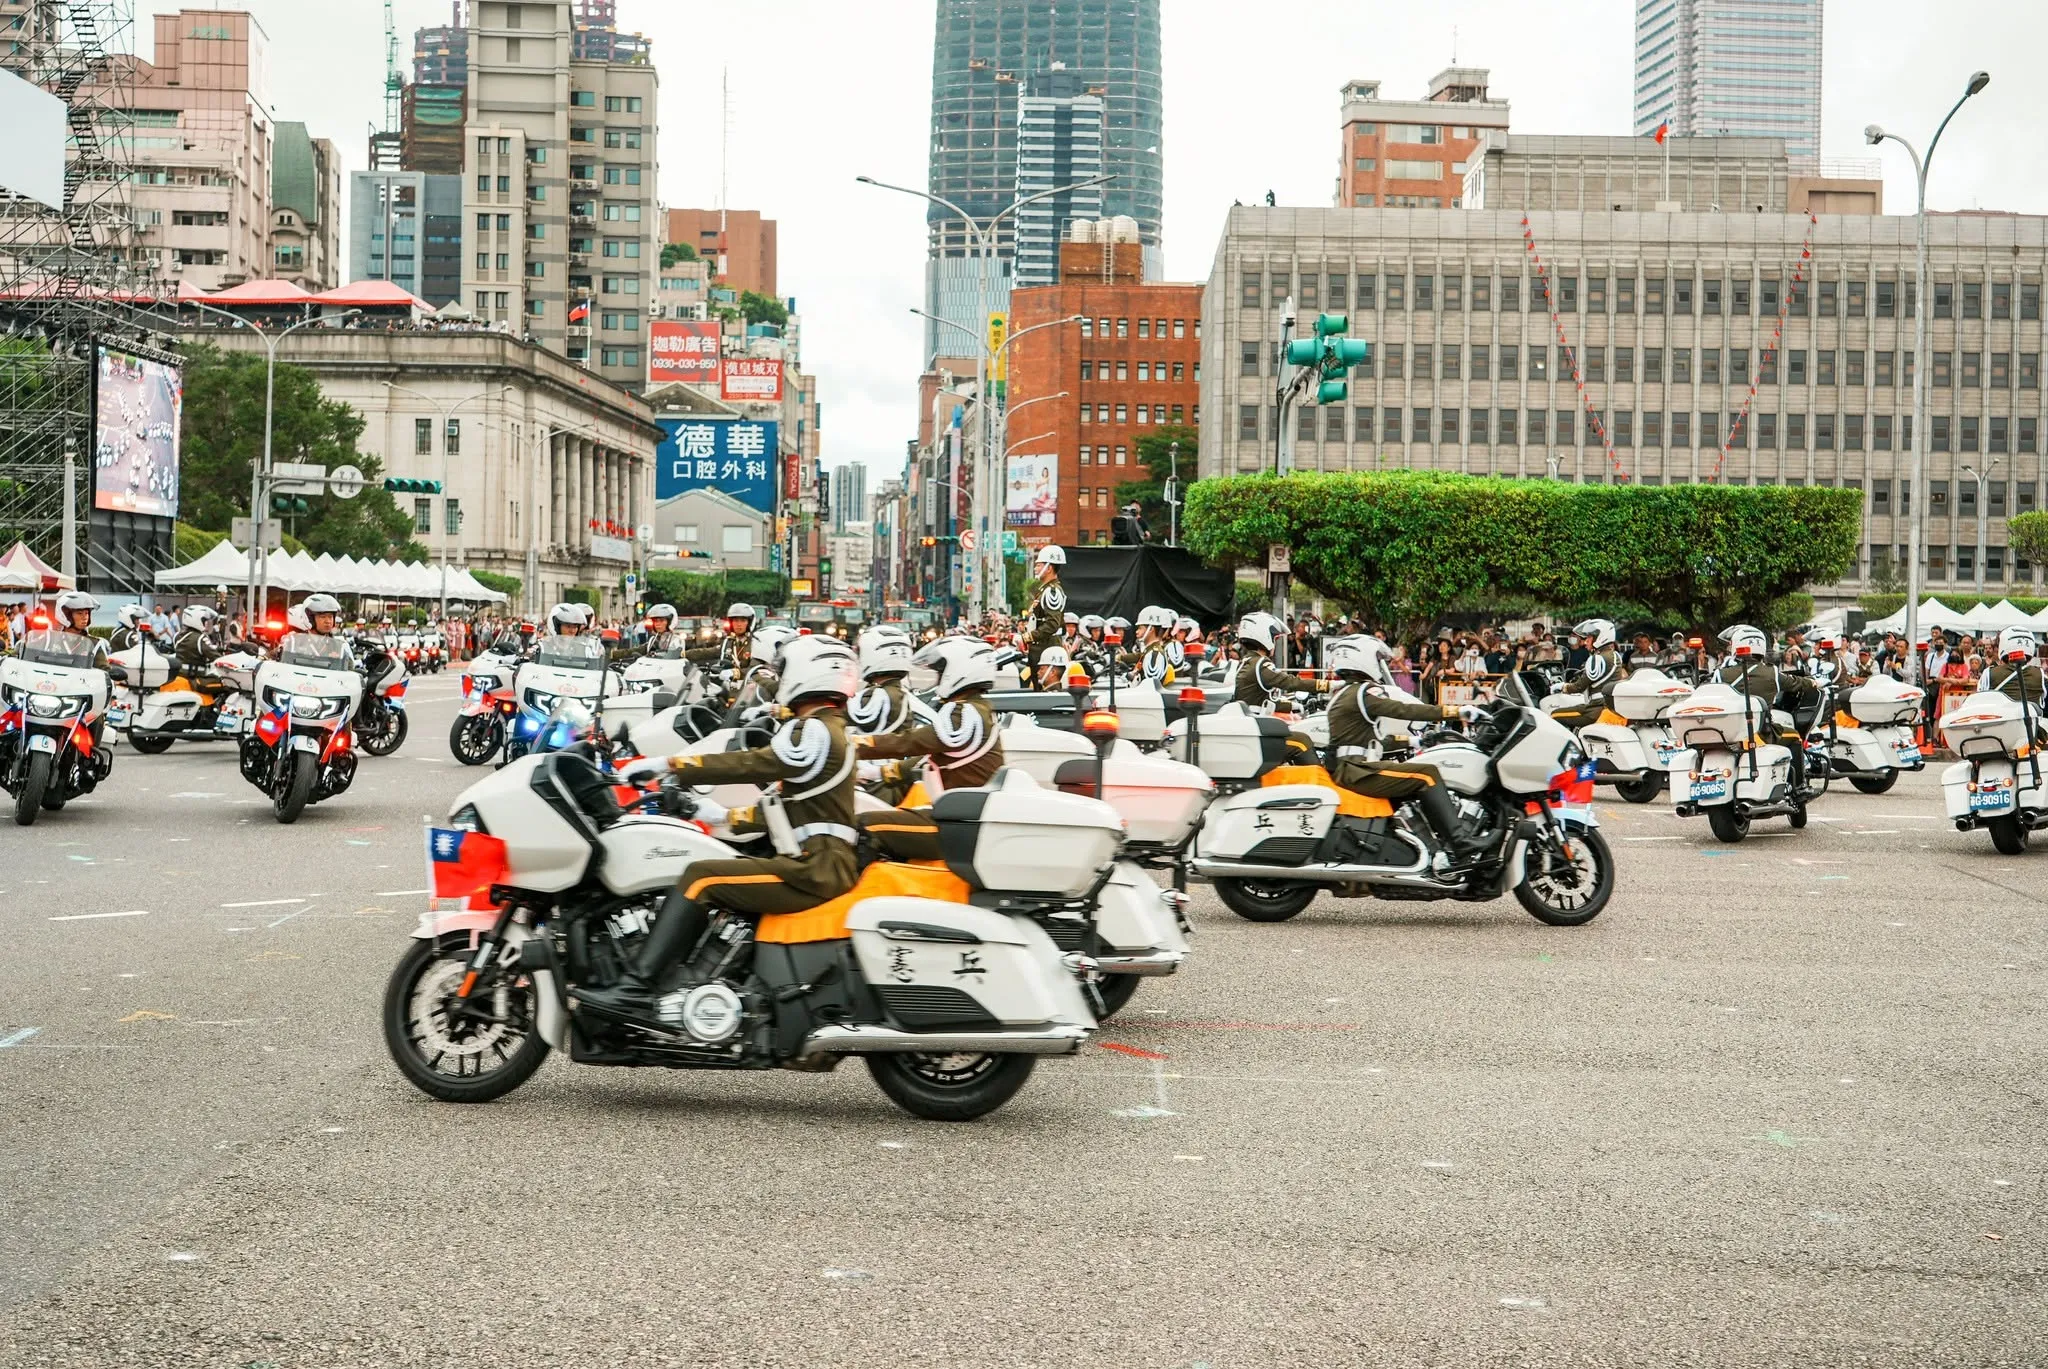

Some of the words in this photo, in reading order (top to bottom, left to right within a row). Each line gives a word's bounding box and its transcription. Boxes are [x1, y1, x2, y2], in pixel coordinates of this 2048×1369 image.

[674, 424, 766, 458] 德華
[673, 460, 767, 480] 口腔外科
